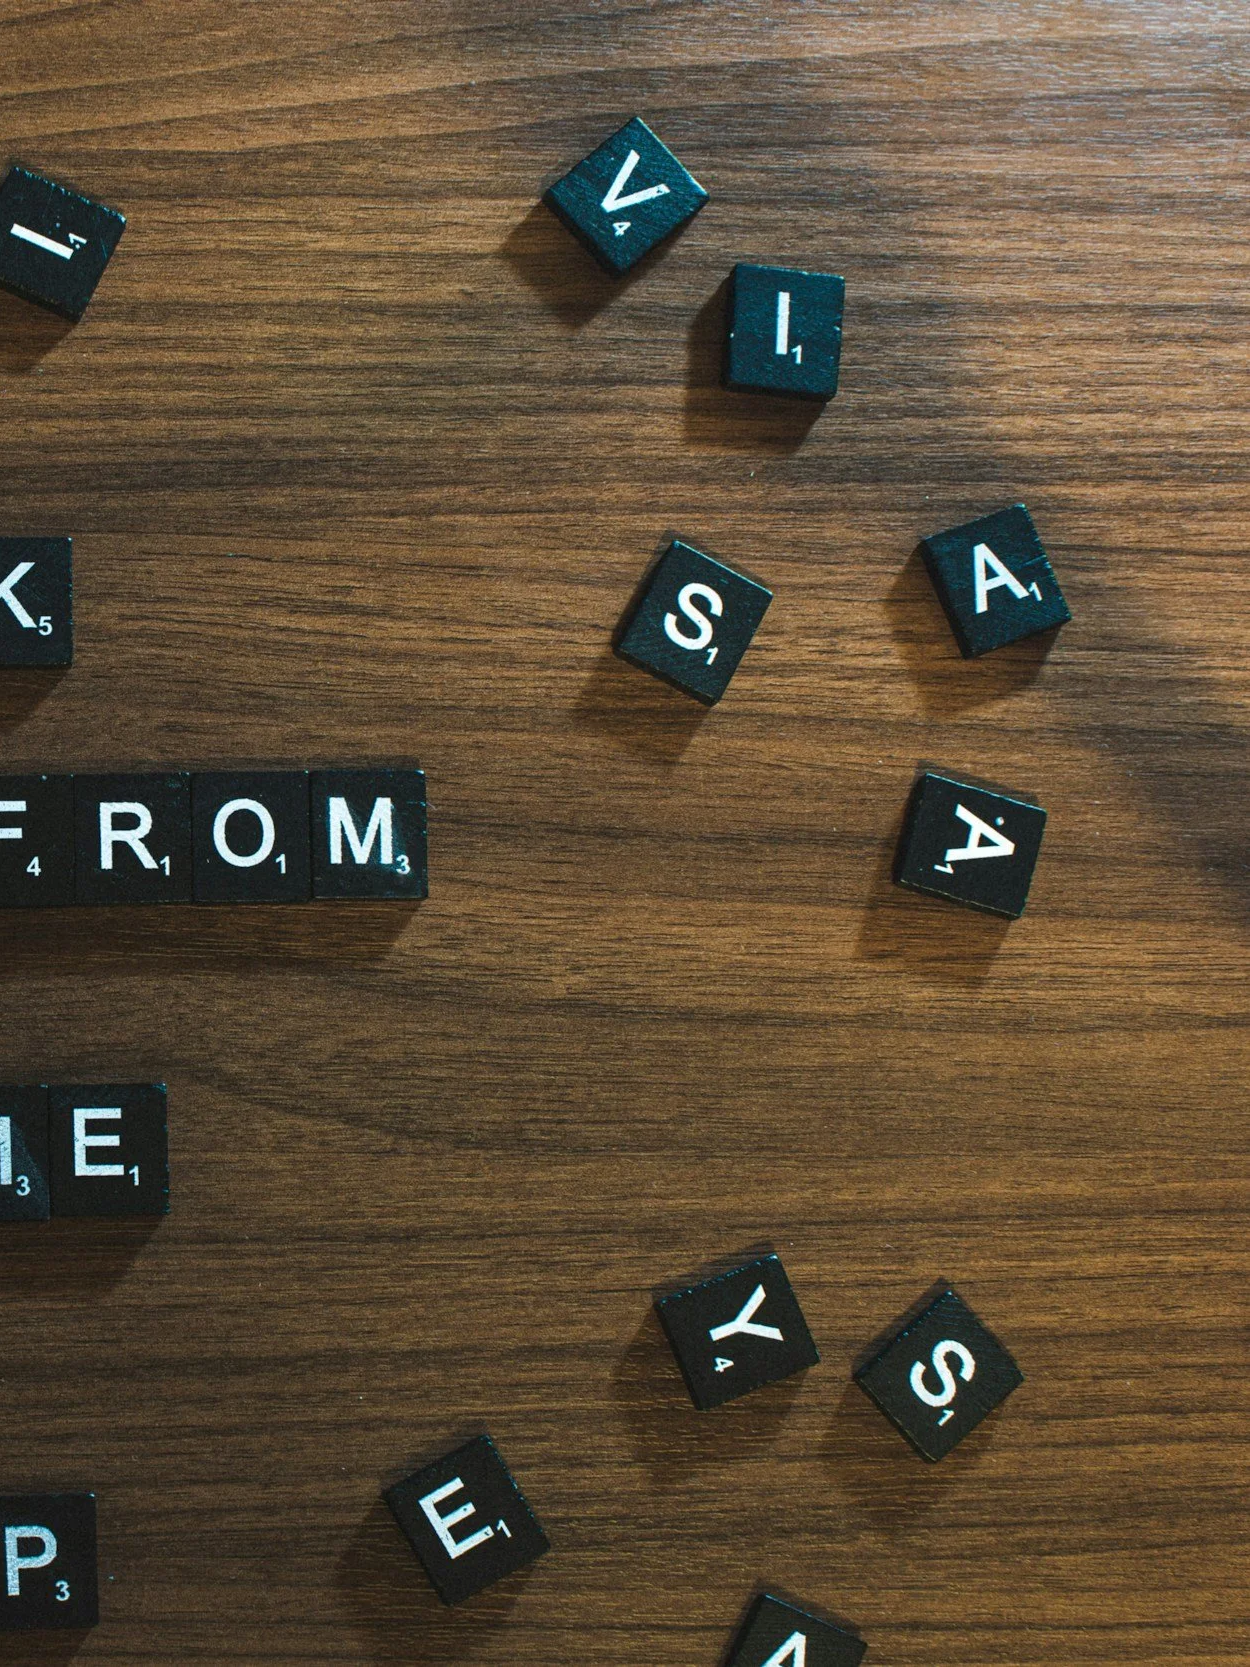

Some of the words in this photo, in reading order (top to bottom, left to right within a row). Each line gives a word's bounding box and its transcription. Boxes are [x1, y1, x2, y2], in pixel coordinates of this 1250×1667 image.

[600, 149, 671, 213] V
[10, 223, 74, 260] I
[68, 232, 87, 245] 1
[612, 221, 632, 237] 4
[775, 291, 791, 355] I
[789, 344, 802, 365] 1
[973, 542, 1028, 614] A
[1024, 581, 1043, 603] 1
[38, 615, 53, 636] 5
[663, 582, 723, 651] S
[706, 646, 719, 666] 1
[944, 803, 1015, 862] A
[26, 856, 42, 877] 4
[159, 855, 170, 876] 1
[275, 853, 286, 874] 1
[395, 854, 411, 875] 3
[933, 861, 954, 874] 1
[16, 1175, 31, 1196] 3
[128, 1165, 140, 1186] 1
[709, 1284, 784, 1342] Y
[714, 1357, 734, 1373] 4
[909, 1339, 976, 1408] S
[937, 1409, 955, 1426] 1
[418, 1477, 495, 1560] E
[496, 1519, 512, 1538] 1
[4, 1525, 57, 1596] P
[55, 1580, 71, 1602] 3
